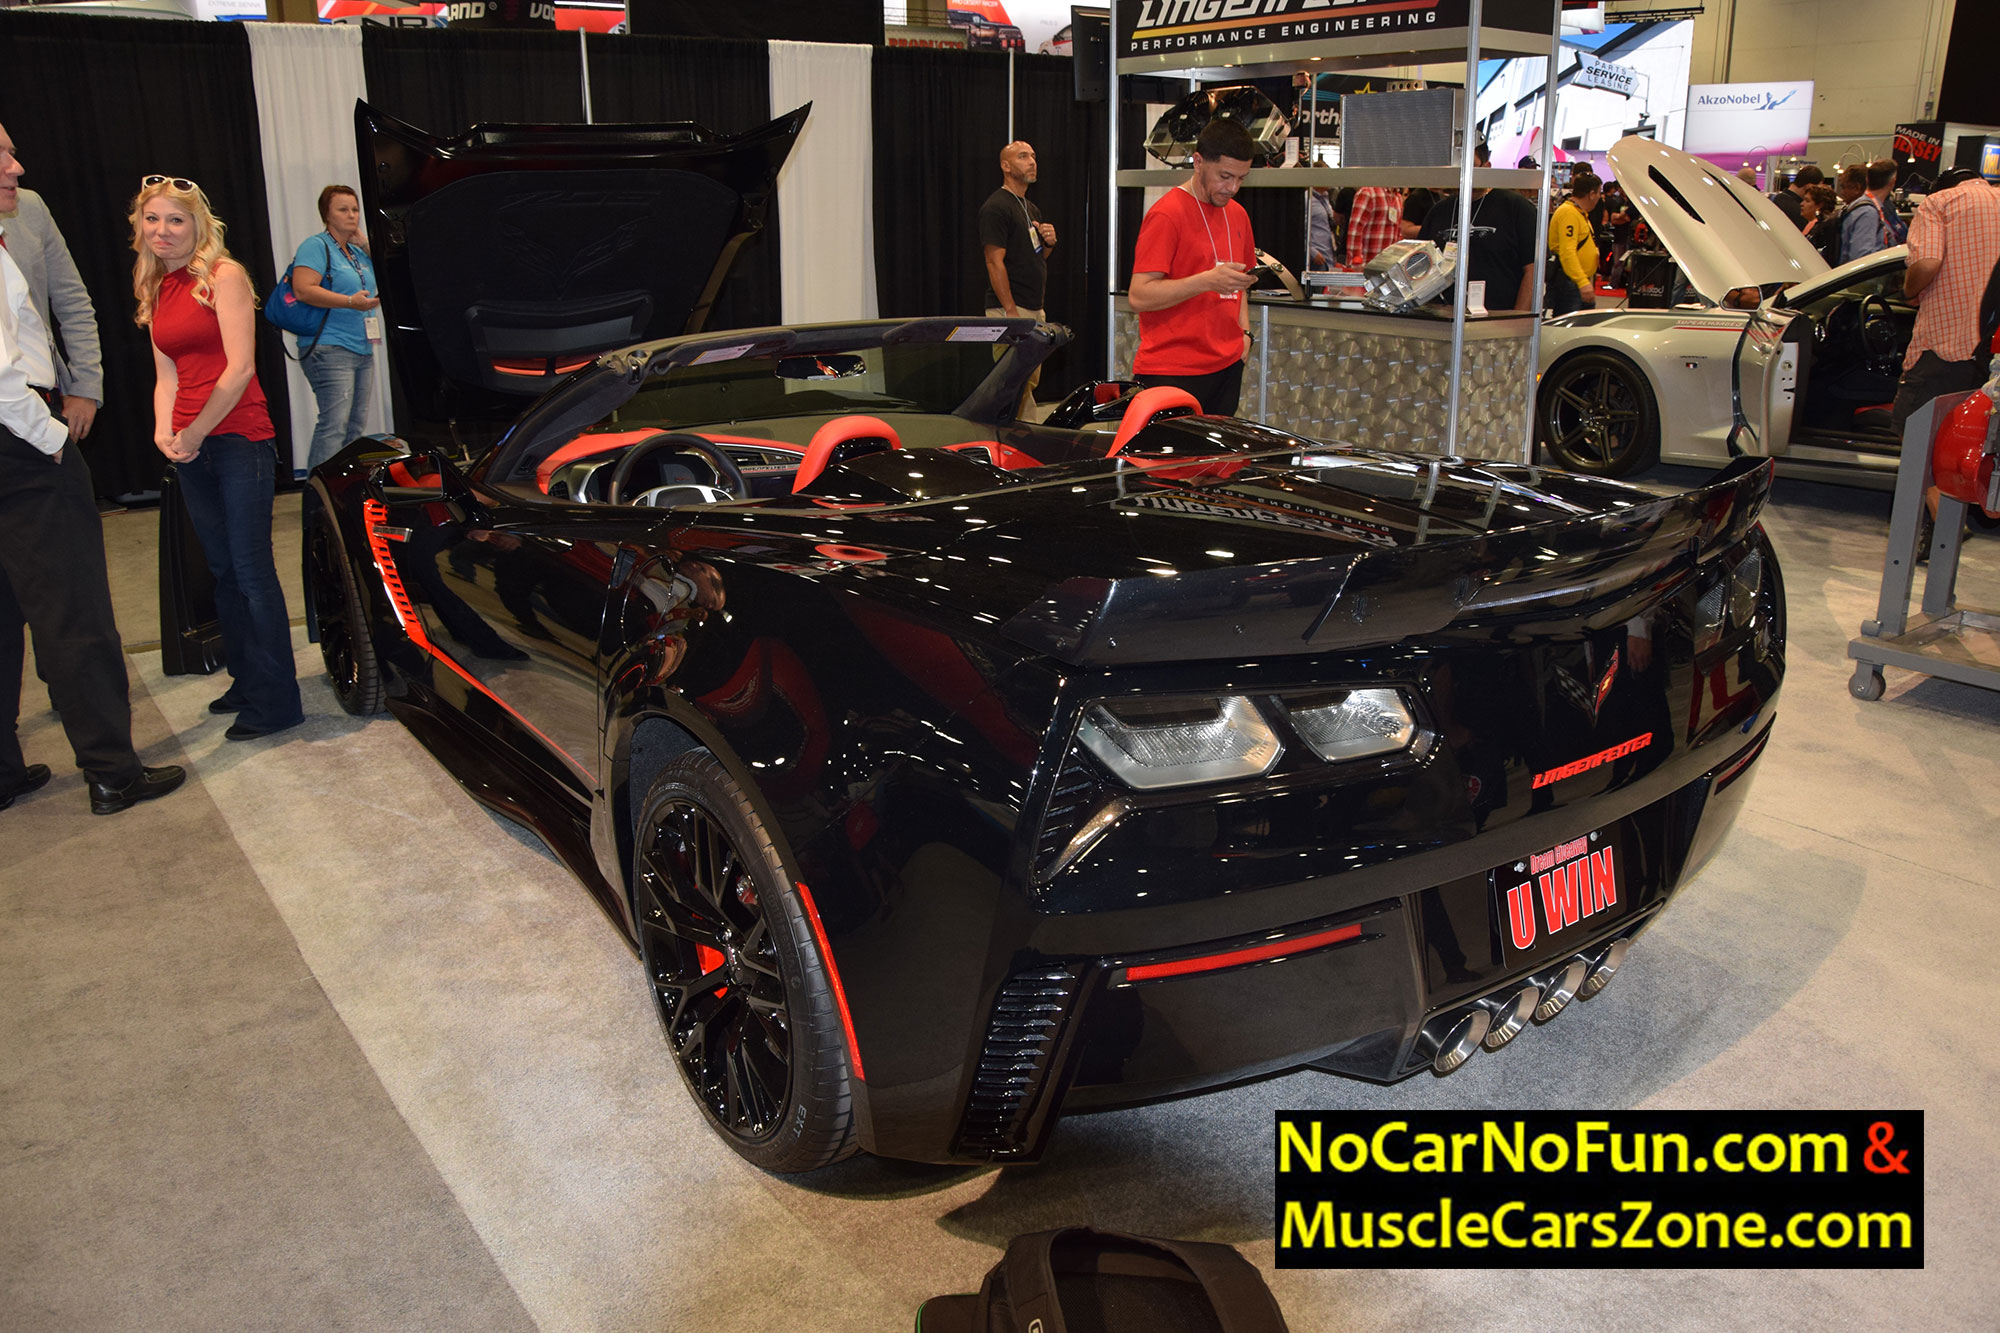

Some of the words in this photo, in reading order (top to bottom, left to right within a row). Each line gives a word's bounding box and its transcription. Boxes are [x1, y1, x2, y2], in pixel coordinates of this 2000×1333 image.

[1131, 28, 1266, 51] PERFORMANCE
[1281, 11, 1436, 36] ENGINEERING
[1586, 66, 1633, 85] SERVICE
[1595, 60, 1627, 75] PARTS
[1587, 75, 1629, 91] LEASING
[1697, 93, 1761, 105] AkzoNobel
[1896, 126, 1927, 140] MADE
[1928, 136, 1940, 146] IN
[1566, 225, 1575, 237] 3
[1531, 732, 1653, 790] LINGENFELTER
[1530, 850, 1555, 875] Dream
[1554, 836, 1588, 865] Giveaway
[1506, 881, 1536, 950] U
[1538, 845, 1617, 935] WIN
